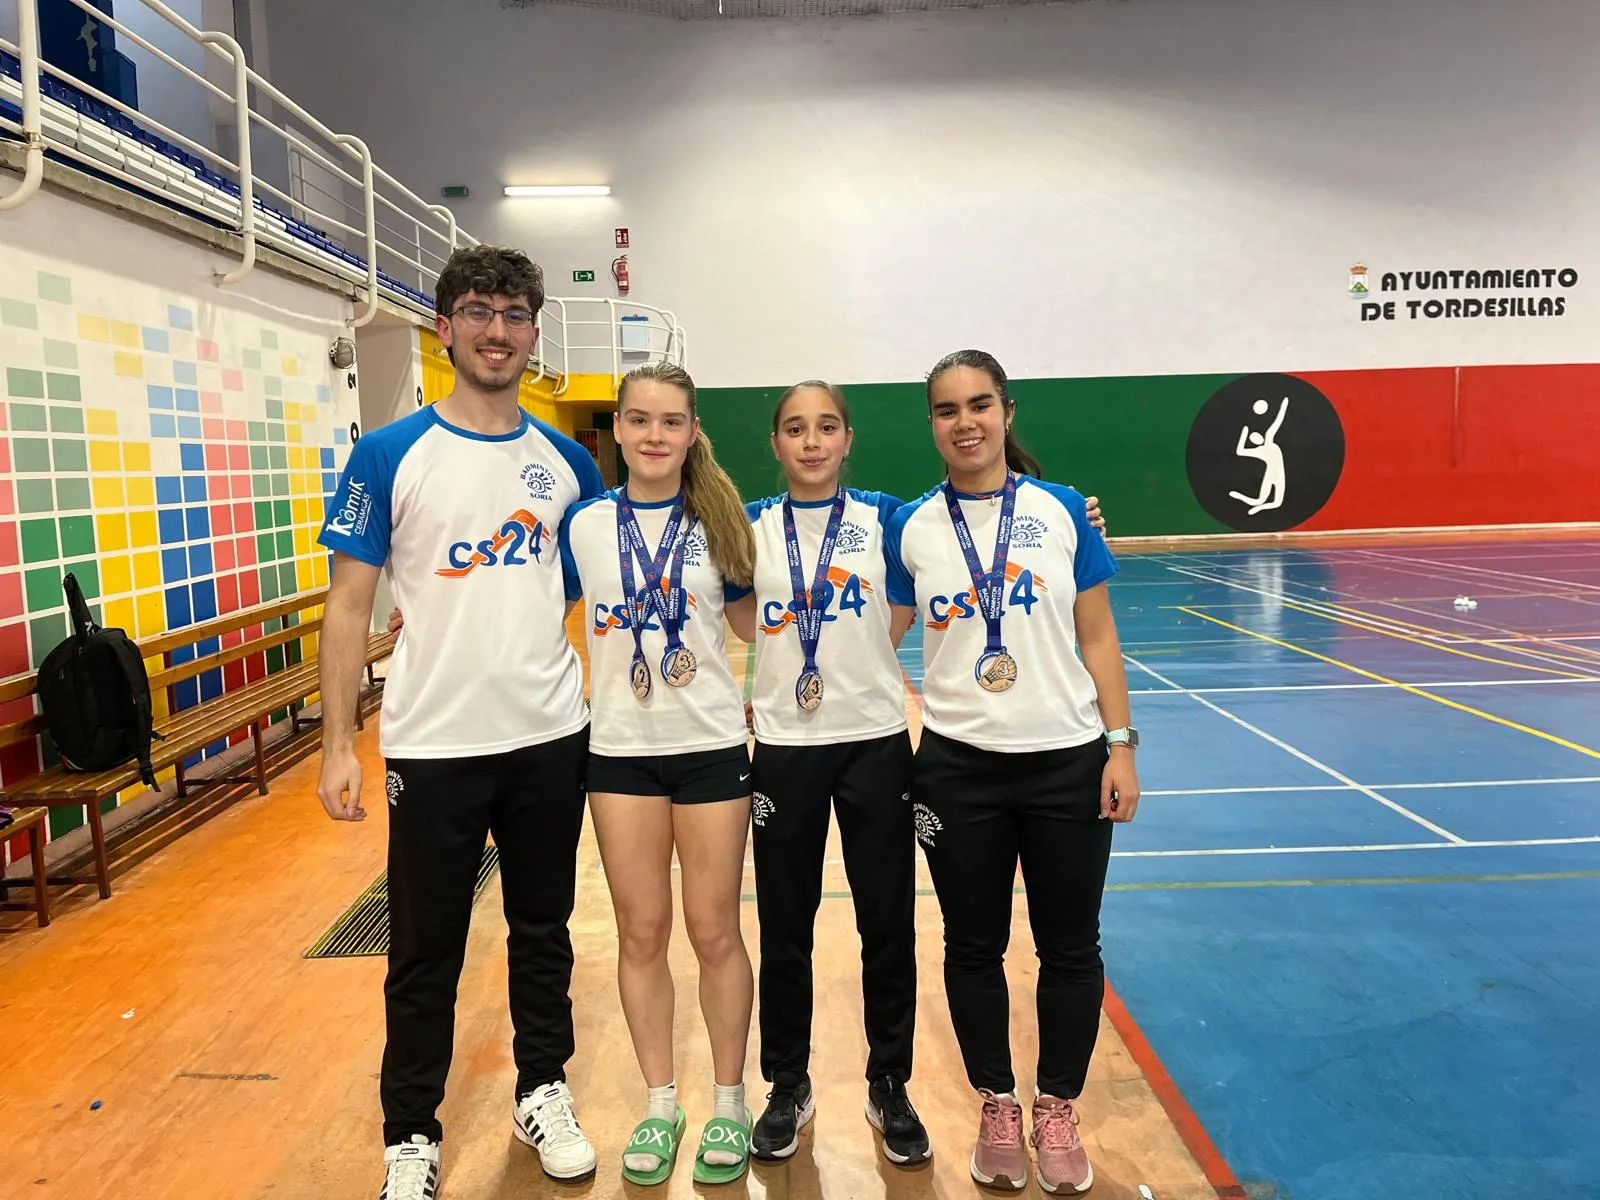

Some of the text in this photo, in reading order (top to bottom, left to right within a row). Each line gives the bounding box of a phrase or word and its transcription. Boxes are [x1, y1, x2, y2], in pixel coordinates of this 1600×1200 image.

[1381, 268, 1578, 292] AYUNTAMIENTO
[1361, 296, 1566, 321] DE TORDESILLAS
[520, 462, 557, 486] BADMINTON
[529, 492, 553, 501] SORIA
[838, 547, 866, 556] SORIA
